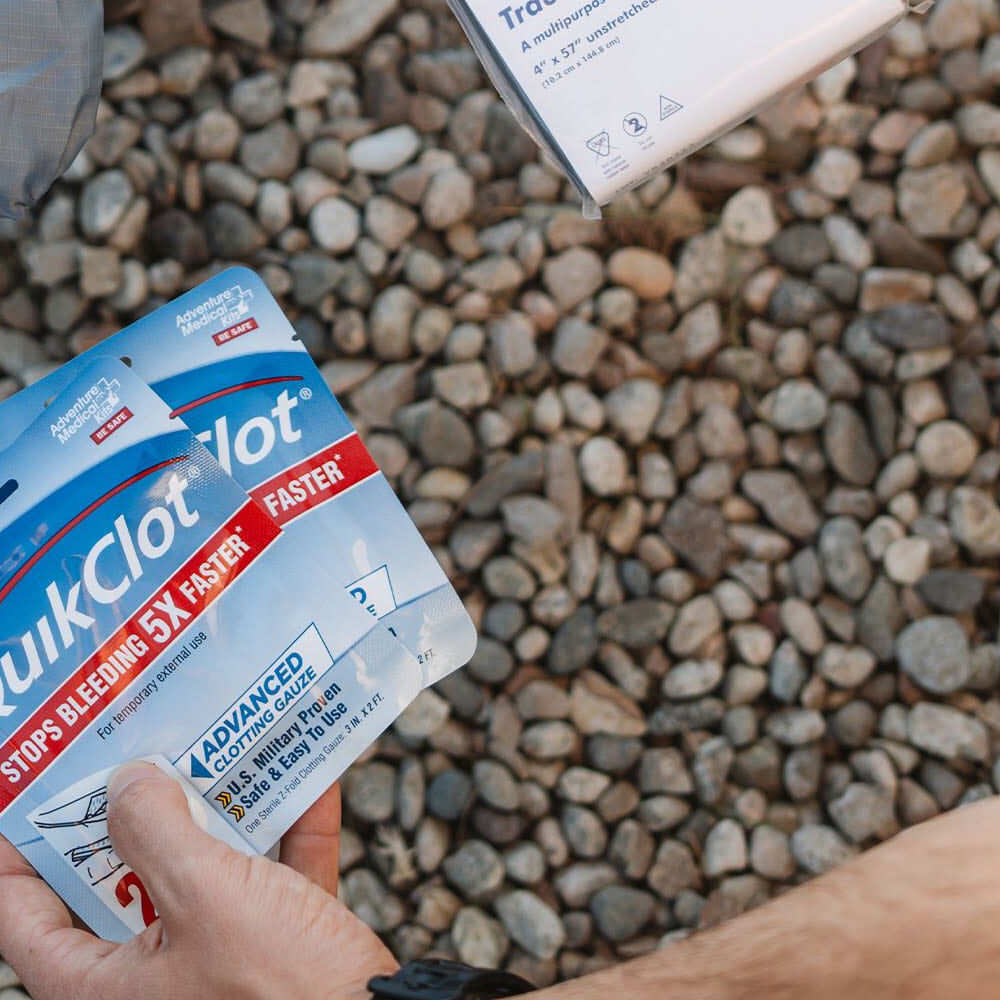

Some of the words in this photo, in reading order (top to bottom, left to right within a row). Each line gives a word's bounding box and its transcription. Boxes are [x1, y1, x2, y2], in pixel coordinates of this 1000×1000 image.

[521, 40, 532, 53] A
[541, 70, 562, 89] (10.2
[564, 64, 575, 74] cm
[581, 46, 605, 63] 144.8
[606, 36, 621, 52] cm)
[551, 56, 560, 66] x
[176, 289, 231, 328] Adventure
[181, 303, 228, 337] Medical
[218, 332, 231, 341] BE
[230, 321, 253, 336] SAFE
[221, 311, 241, 327] Kits
[50, 386, 99, 437] Adventure
[57, 400, 100, 444] Medical
[94, 404, 113, 424] Kits
[96, 428, 108, 440] BE
[107, 412, 127, 430] SAFE
[0, 718, 63, 783] STOPS
[56, 633, 149, 727] BLEEDING
[138, 590, 191, 645] 5X
[96, 722, 115, 740] For
[113, 680, 159, 725] temporary
[156, 645, 191, 682] external
[189, 631, 207, 649] use
[201, 652, 303, 763] ADVANCED
[214, 709, 274, 773] CLOTTING
[274, 665, 317, 713] GAUZE
[227, 769, 256, 796] U.S.
[252, 721, 302, 771] Military
[297, 683, 342, 725] Proven
[239, 783, 271, 809] Safe
[270, 767, 284, 781] &
[278, 740, 311, 771] Easy
[305, 725, 325, 742] To
[321, 702, 348, 726] Use
[245, 817, 260, 834] One
[260, 798, 281, 820] Sterile
[279, 775, 301, 801] Z-Fold
[299, 752, 327, 781] Clotting
[322, 732, 348, 756] Gauze:
[344, 724, 352, 734] 3
[349, 715, 363, 729] IN.
[362, 707, 370, 717] X
[367, 701, 374, 712] 2
[371, 692, 385, 706] FT.
